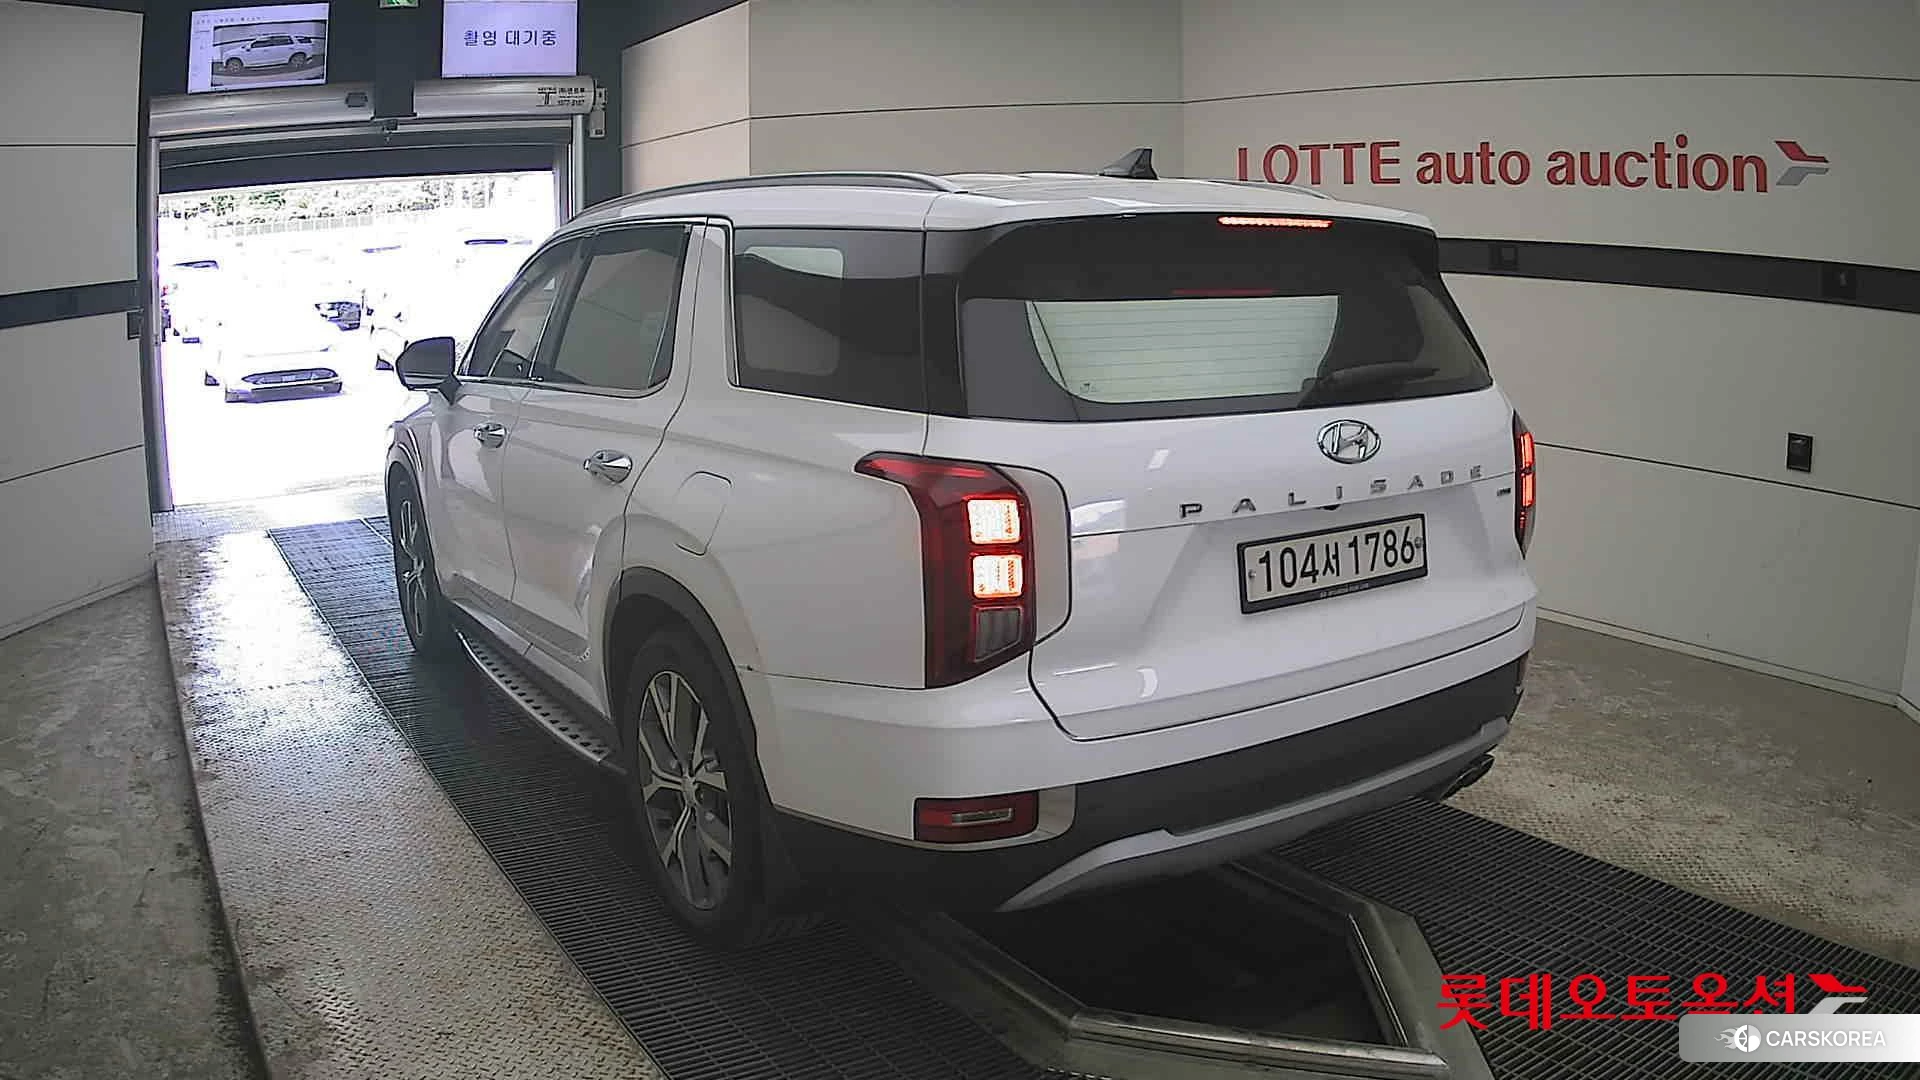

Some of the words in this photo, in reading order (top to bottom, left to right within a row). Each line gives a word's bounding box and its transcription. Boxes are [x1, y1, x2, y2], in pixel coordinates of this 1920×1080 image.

[505, 30, 557, 46] 대기중
[1416, 142, 1531, 185] auto
[1546, 134, 1768, 193] auction
[1179, 465, 1483, 518] PALISADE
